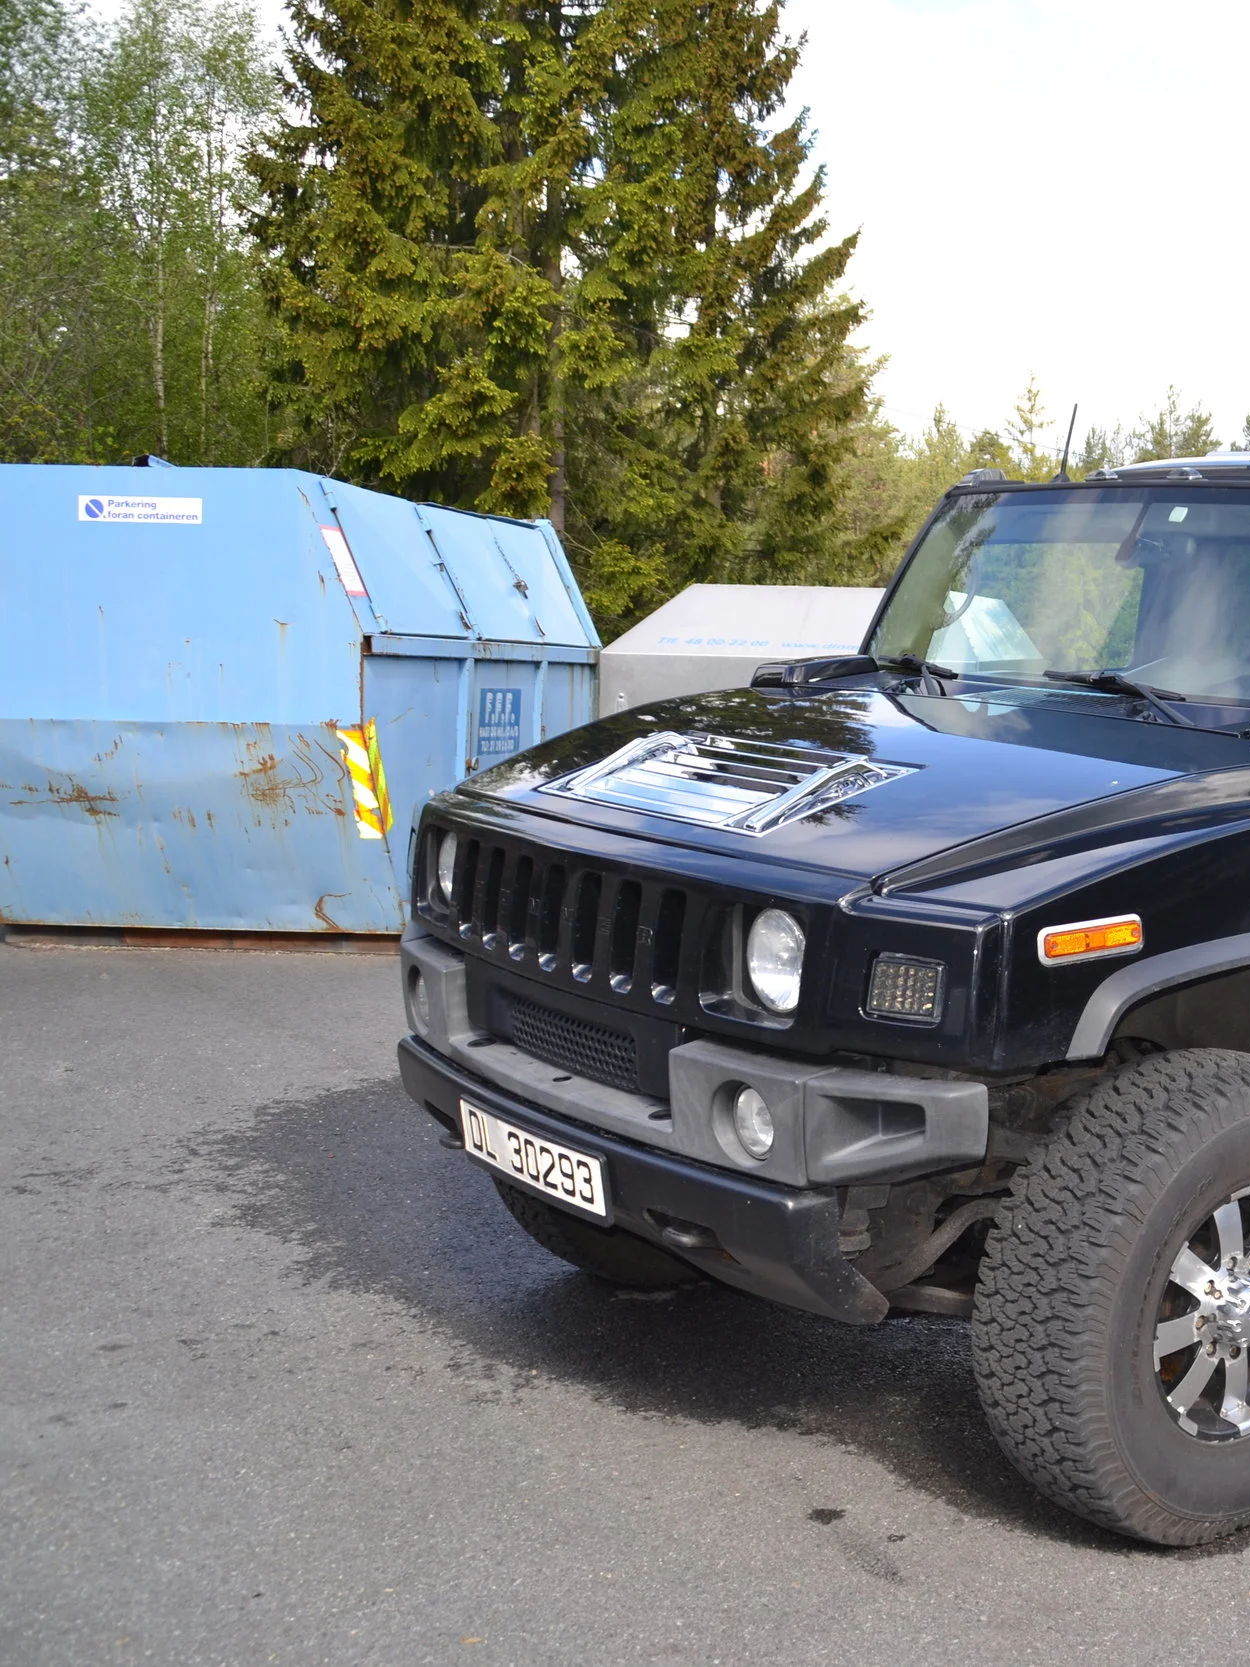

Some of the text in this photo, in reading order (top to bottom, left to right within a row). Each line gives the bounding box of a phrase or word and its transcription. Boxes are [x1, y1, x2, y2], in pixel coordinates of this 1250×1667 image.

[107, 499, 157, 511] Parkering
[107, 511, 198, 521] foran containeren
[468, 1109, 595, 1205] DL 30293
